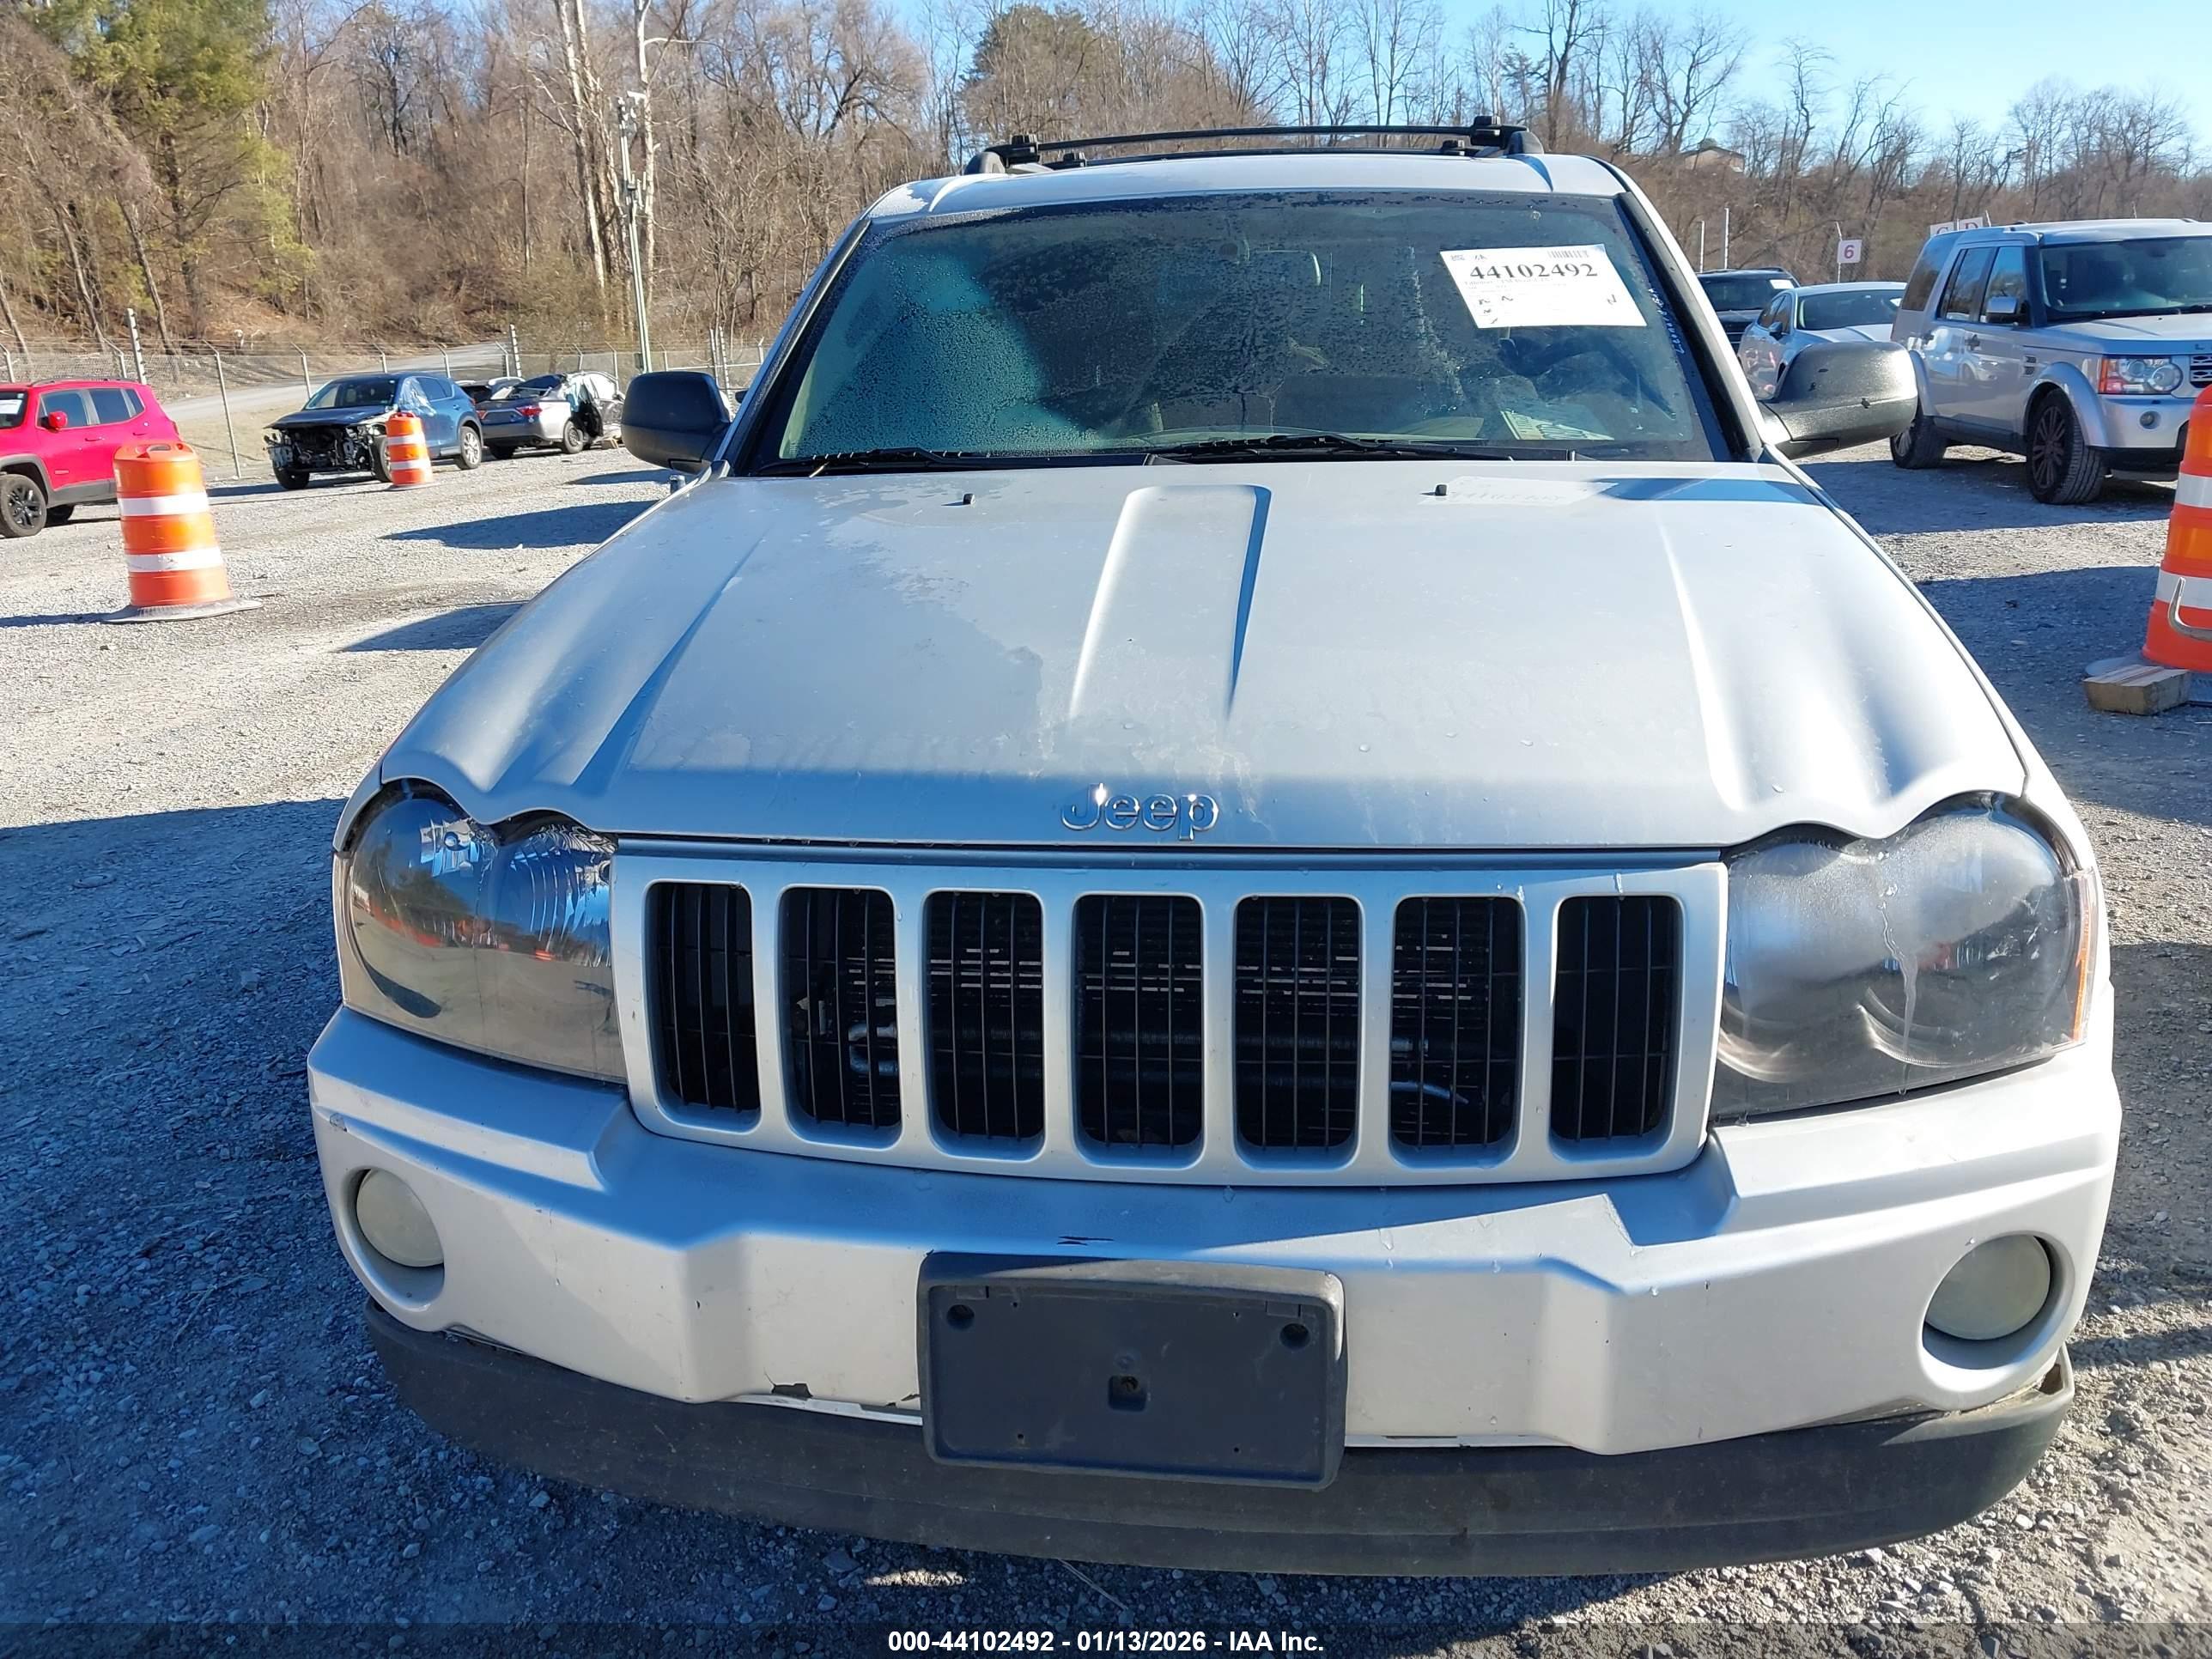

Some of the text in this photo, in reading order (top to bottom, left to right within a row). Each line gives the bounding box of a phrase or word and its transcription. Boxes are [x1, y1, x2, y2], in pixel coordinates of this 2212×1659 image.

[1844, 244, 1855, 259] 6
[1469, 263, 1598, 279] 44102492
[1060, 782, 1219, 842] Jeep
